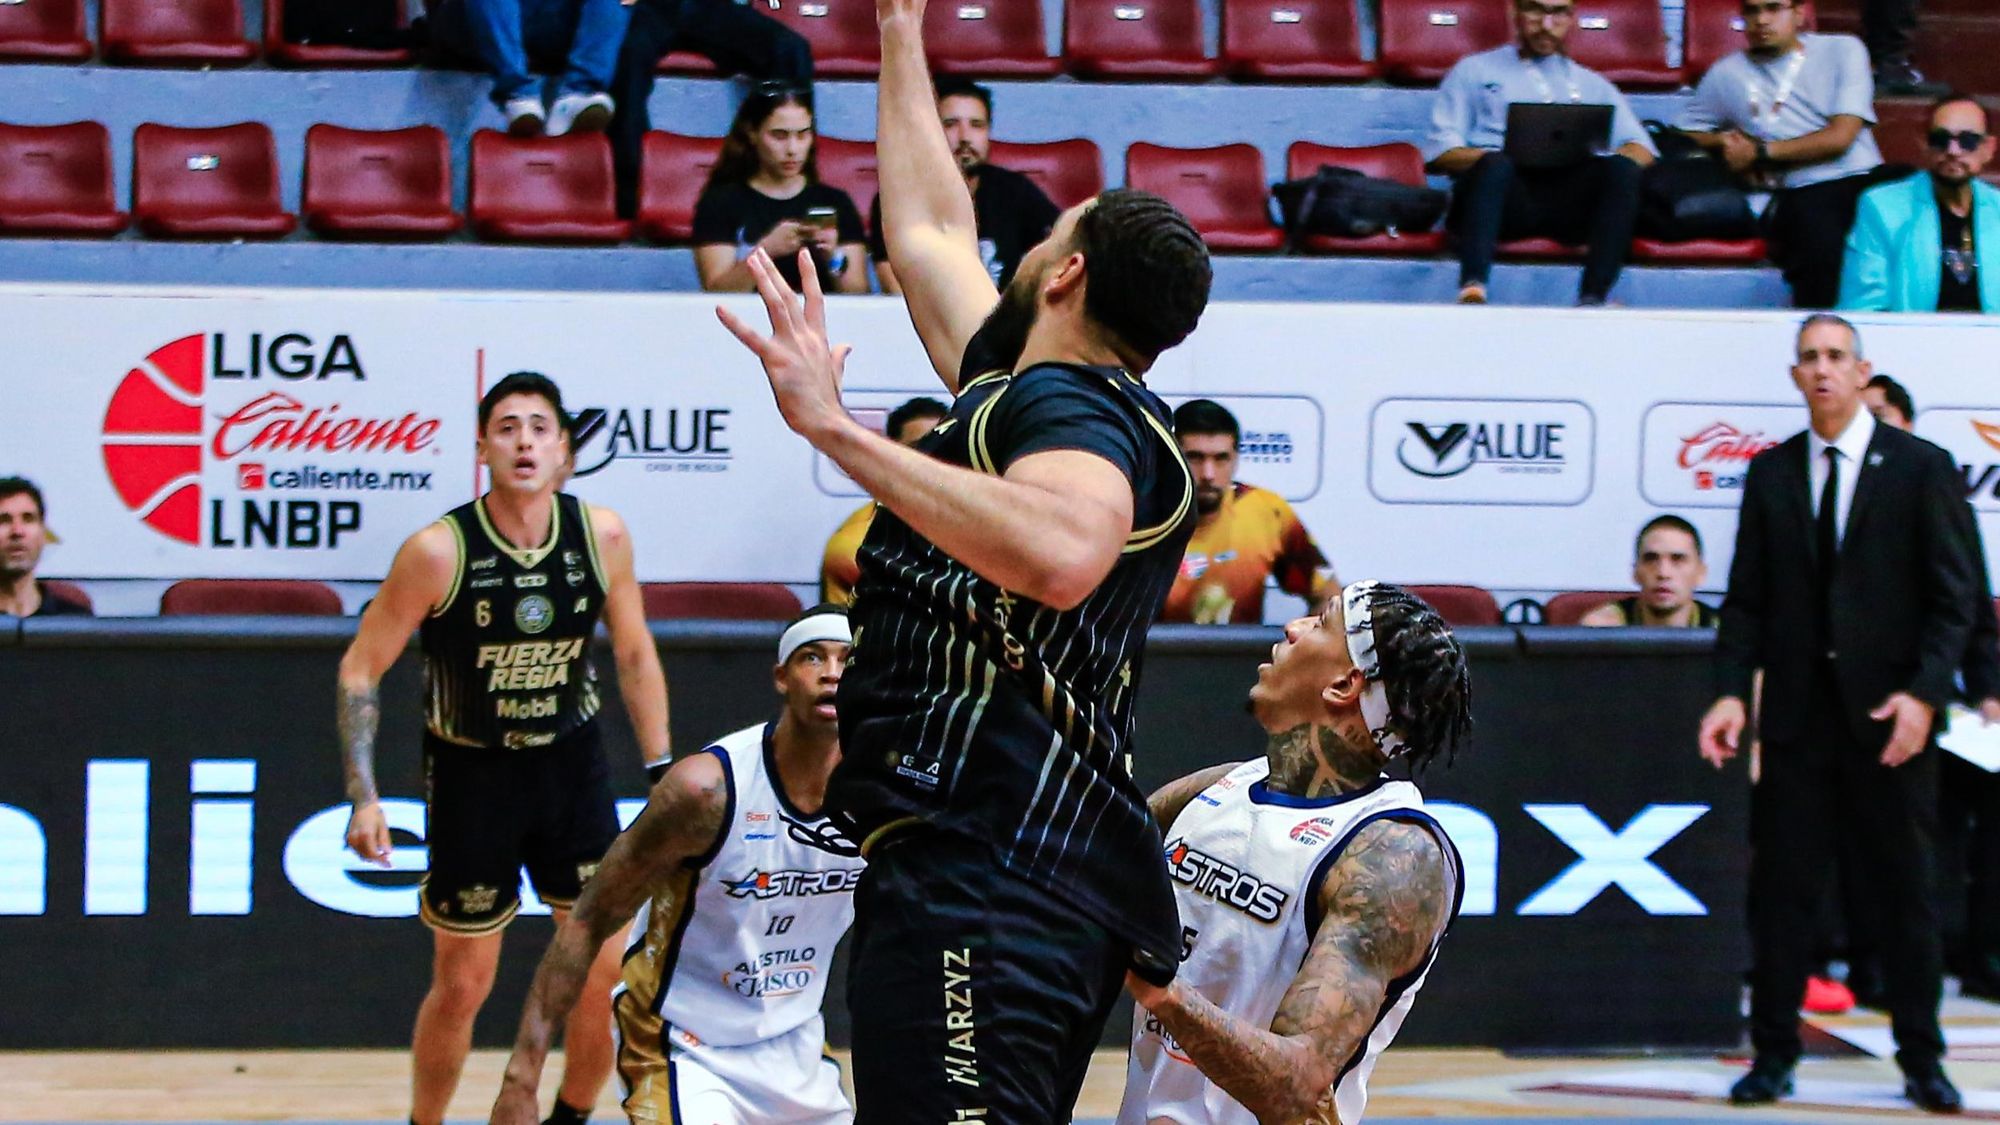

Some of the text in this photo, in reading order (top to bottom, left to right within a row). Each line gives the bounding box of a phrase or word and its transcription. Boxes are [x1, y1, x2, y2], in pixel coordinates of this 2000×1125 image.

[212, 332, 366, 381] LIGA
[212, 391, 441, 461] Caliente
[1405, 422, 1566, 466] VALUE
[268, 465, 433, 491] caliente.mx
[211, 499, 362, 548] LNBP
[475, 600, 491, 627] 6
[476, 638, 584, 669] FUERZA
[488, 663, 569, 693] REGIA
[497, 695, 558, 719] Mobil
[720, 867, 862, 900] ASTROS
[1164, 836, 1289, 924] ASTROS
[764, 915, 795, 937] 10
[759, 946, 817, 968] STILO
